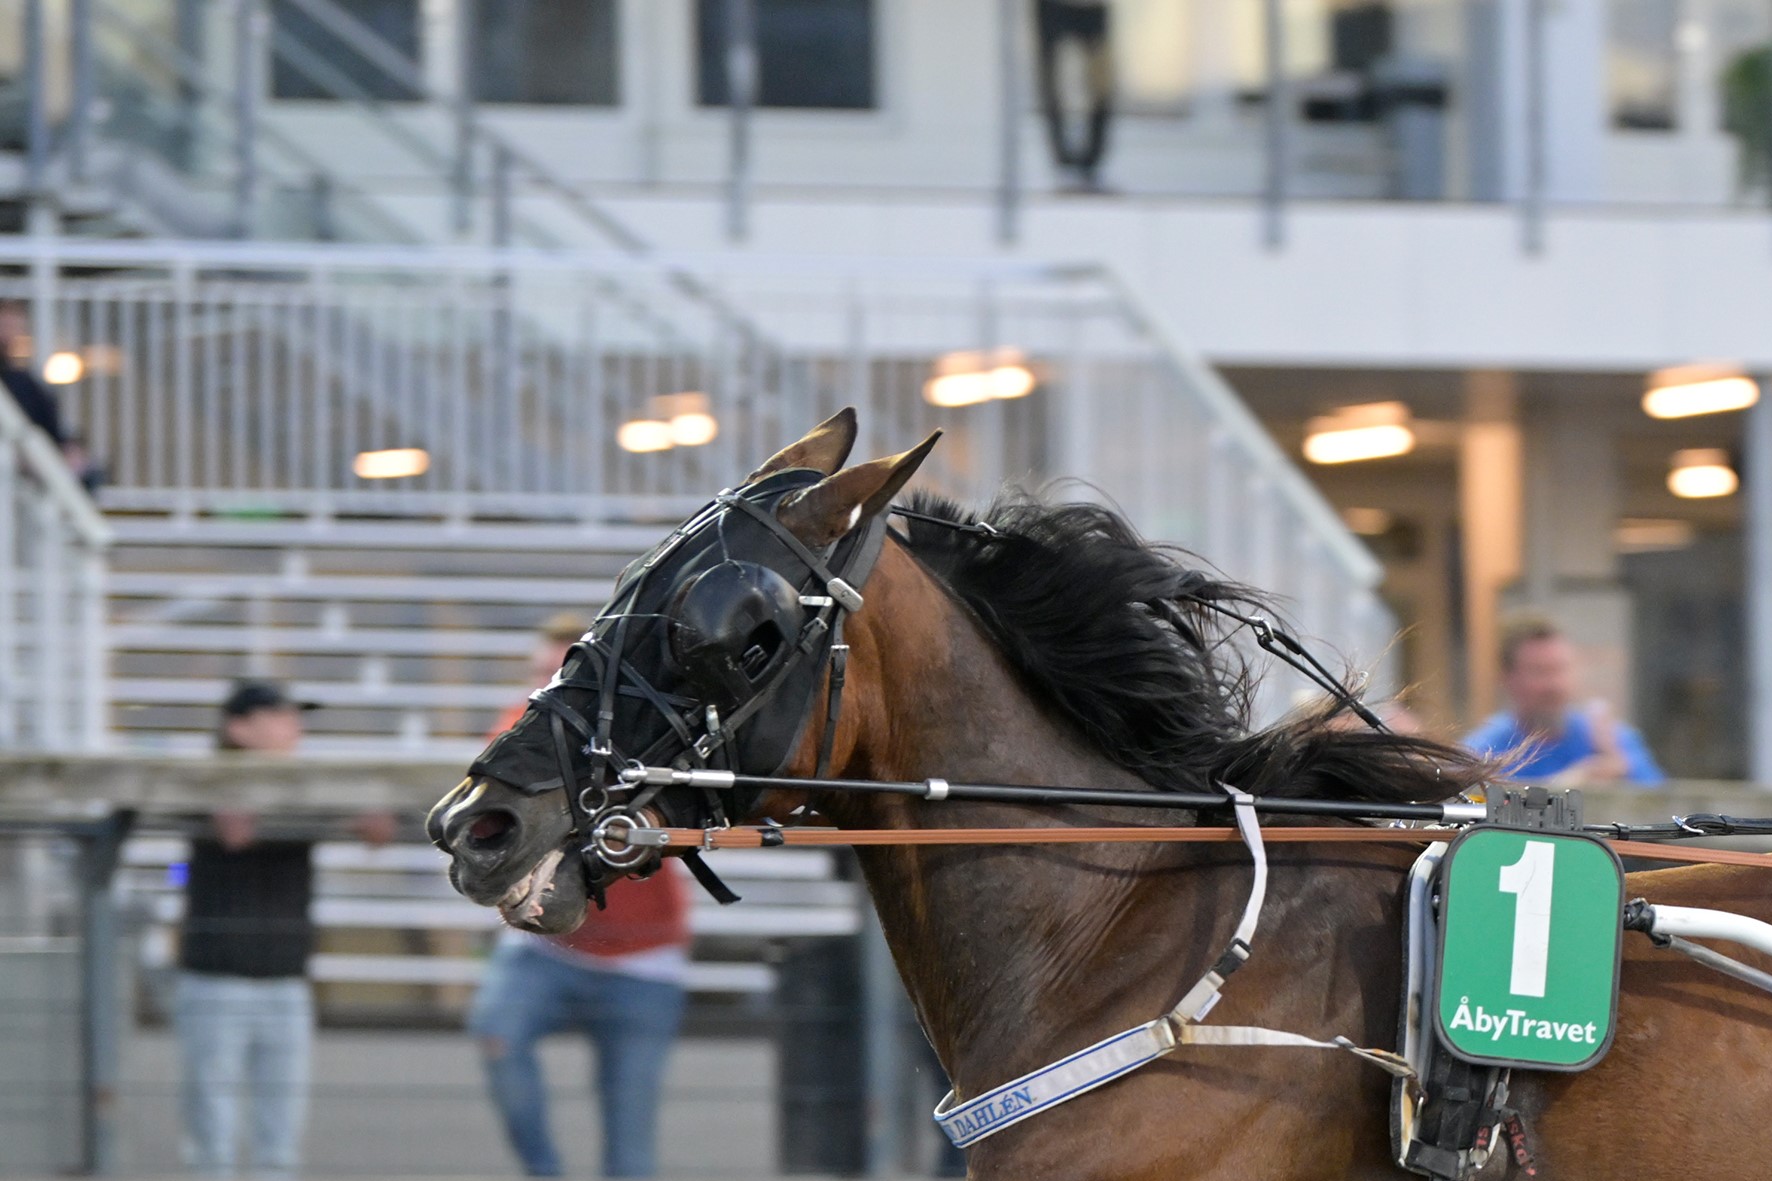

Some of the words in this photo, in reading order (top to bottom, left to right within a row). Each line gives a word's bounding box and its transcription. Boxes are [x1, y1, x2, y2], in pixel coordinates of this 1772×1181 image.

[1498, 840, 1556, 998] 1
[1449, 995, 1597, 1044] ÅbyTravet
[952, 1086, 1034, 1138] DAHLÉN
